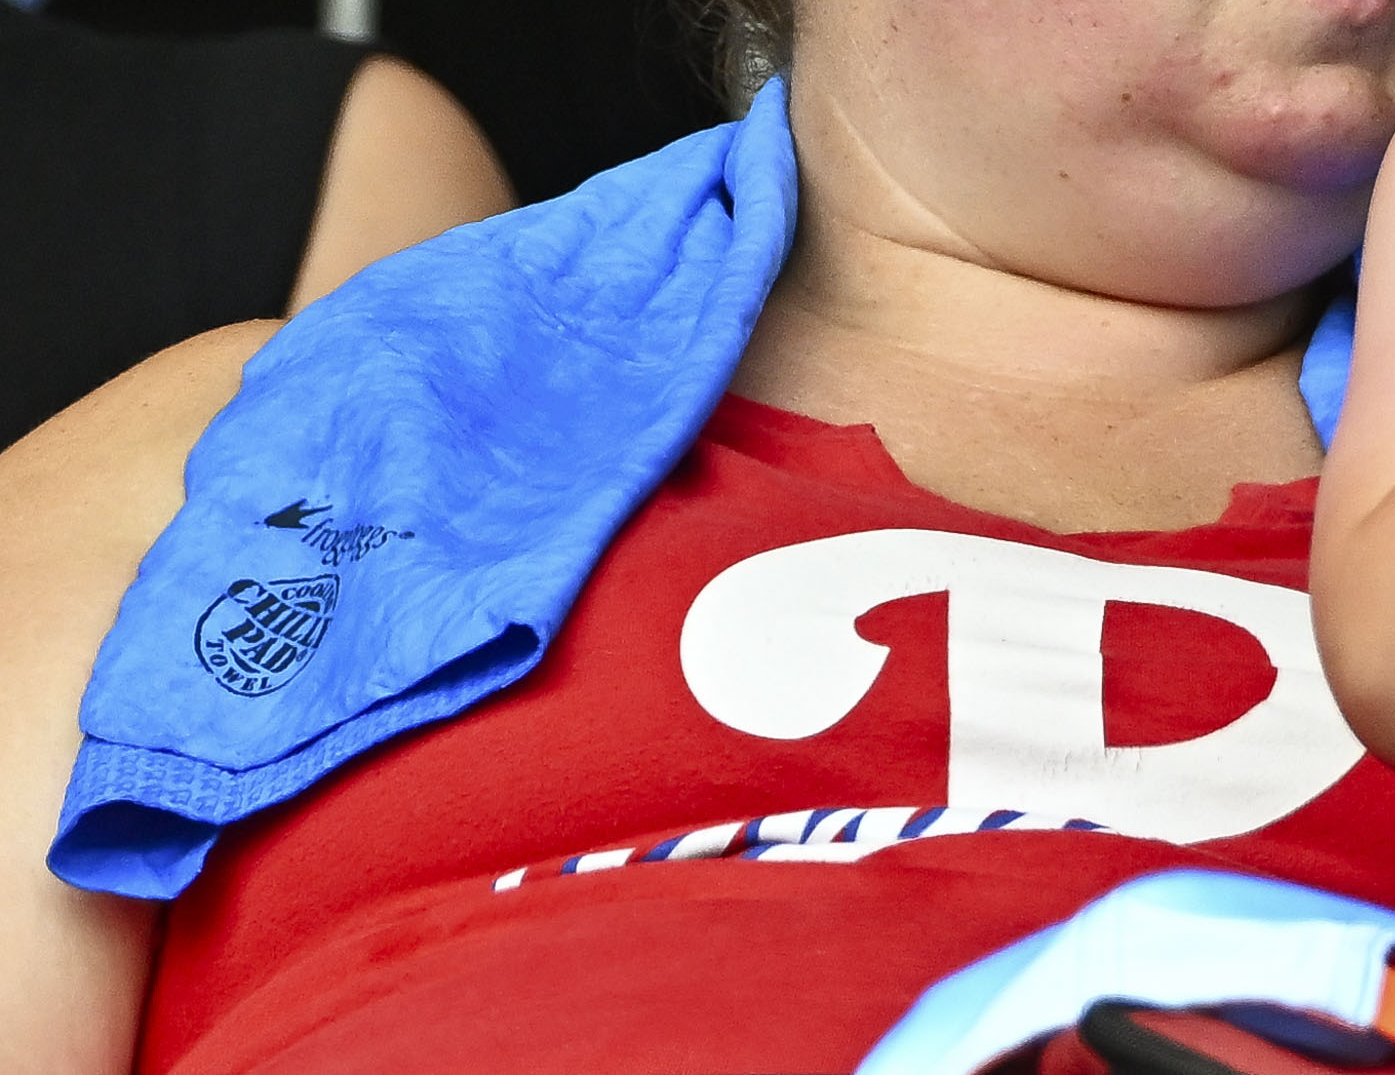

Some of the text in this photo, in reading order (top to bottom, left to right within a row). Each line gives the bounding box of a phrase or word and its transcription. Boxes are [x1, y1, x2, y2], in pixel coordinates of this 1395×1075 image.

[205, 638, 273, 693] TOWEL
[221, 617, 298, 673] PAD
[680, 528, 1368, 845] P
